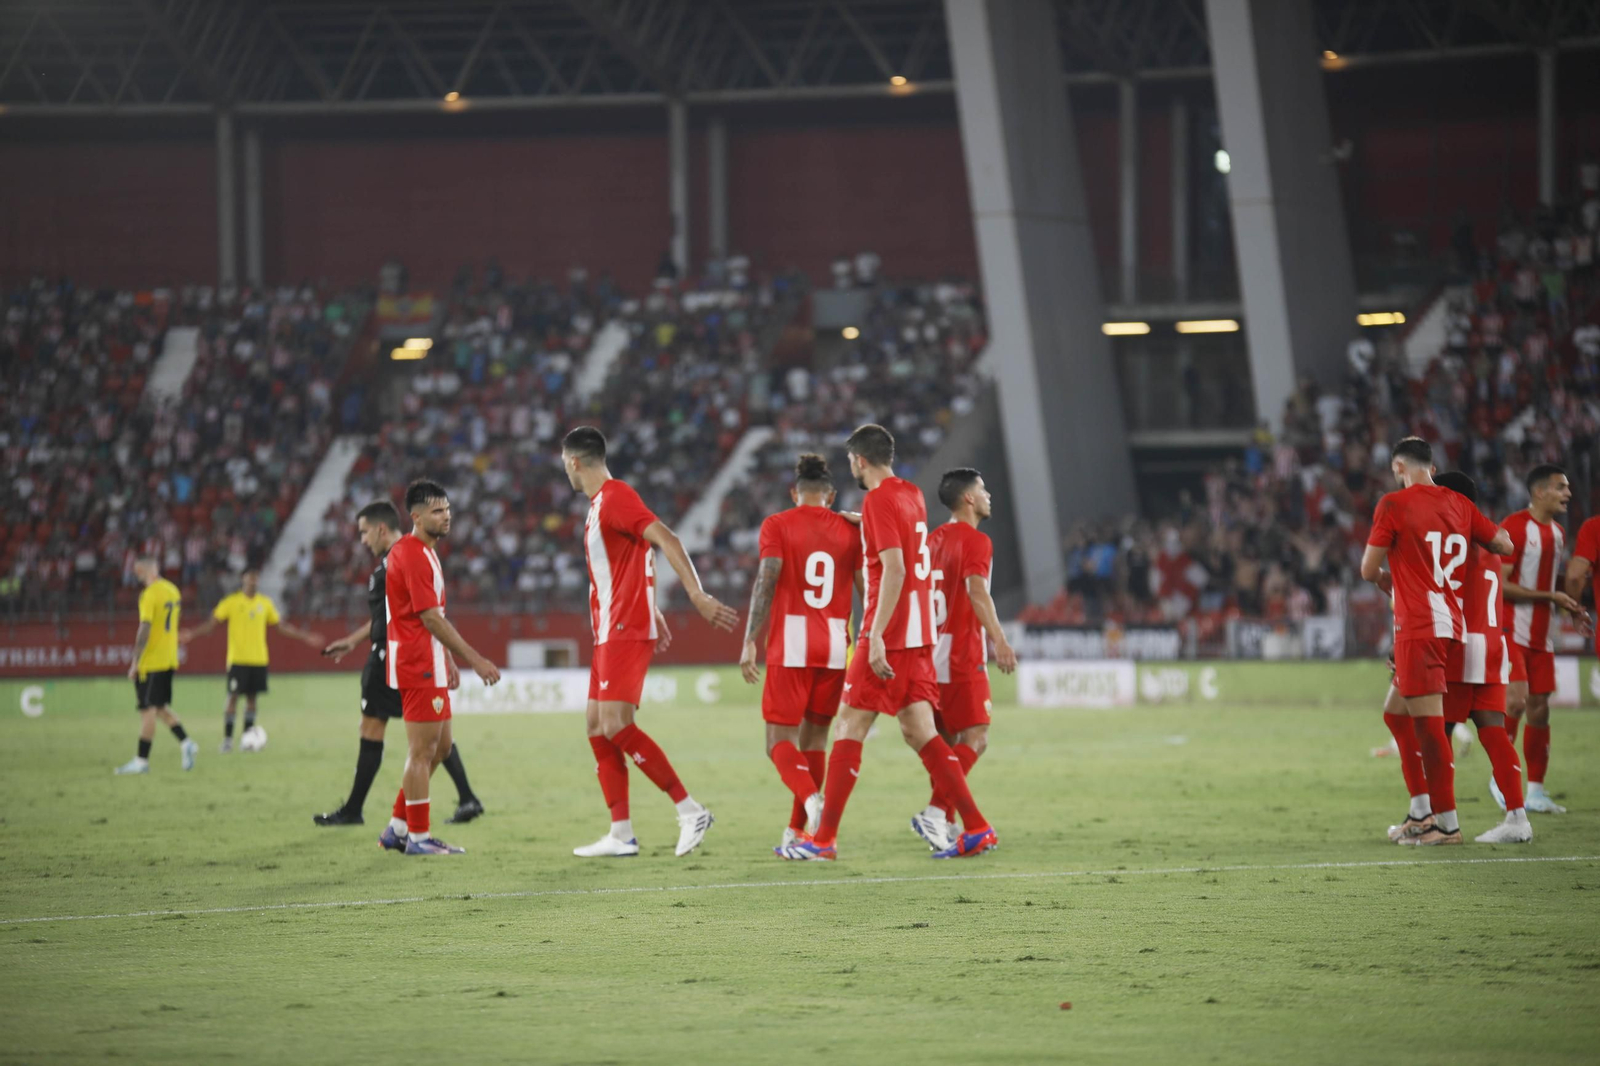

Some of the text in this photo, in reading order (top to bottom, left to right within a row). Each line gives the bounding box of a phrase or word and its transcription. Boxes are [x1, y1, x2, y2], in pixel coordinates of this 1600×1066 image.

[914, 521, 931, 580] 3
[1425, 531, 1467, 590] 12
[803, 551, 835, 609] 9
[931, 569, 948, 626] 5
[1484, 569, 1499, 627] 7
